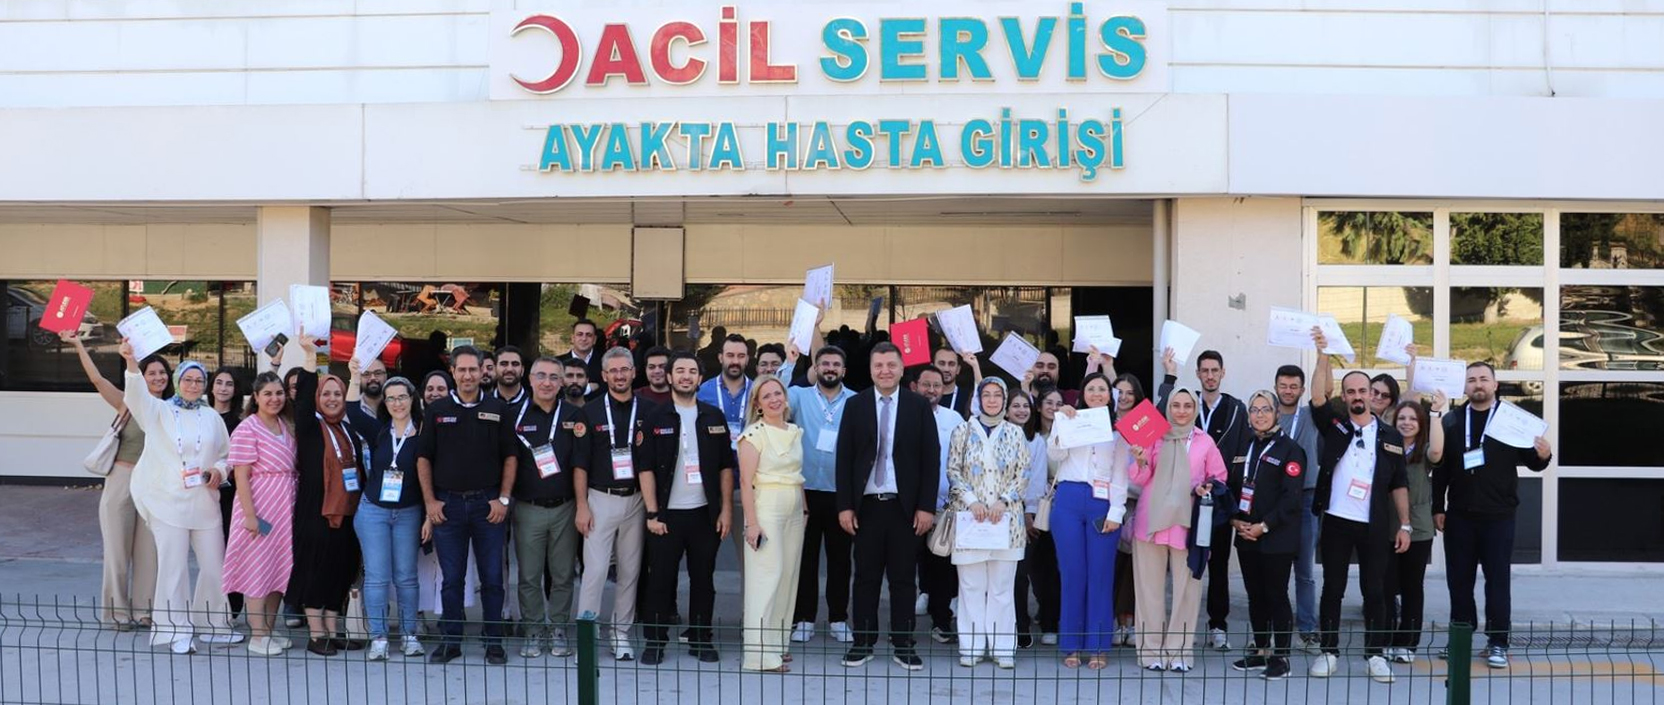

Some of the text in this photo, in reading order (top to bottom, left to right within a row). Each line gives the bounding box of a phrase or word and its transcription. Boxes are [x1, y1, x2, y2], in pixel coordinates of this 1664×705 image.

[585, 1, 1147, 86] ACİL SERVİS
[538, 106, 1126, 182] AYAKTA HASTA GİRİŞİ
